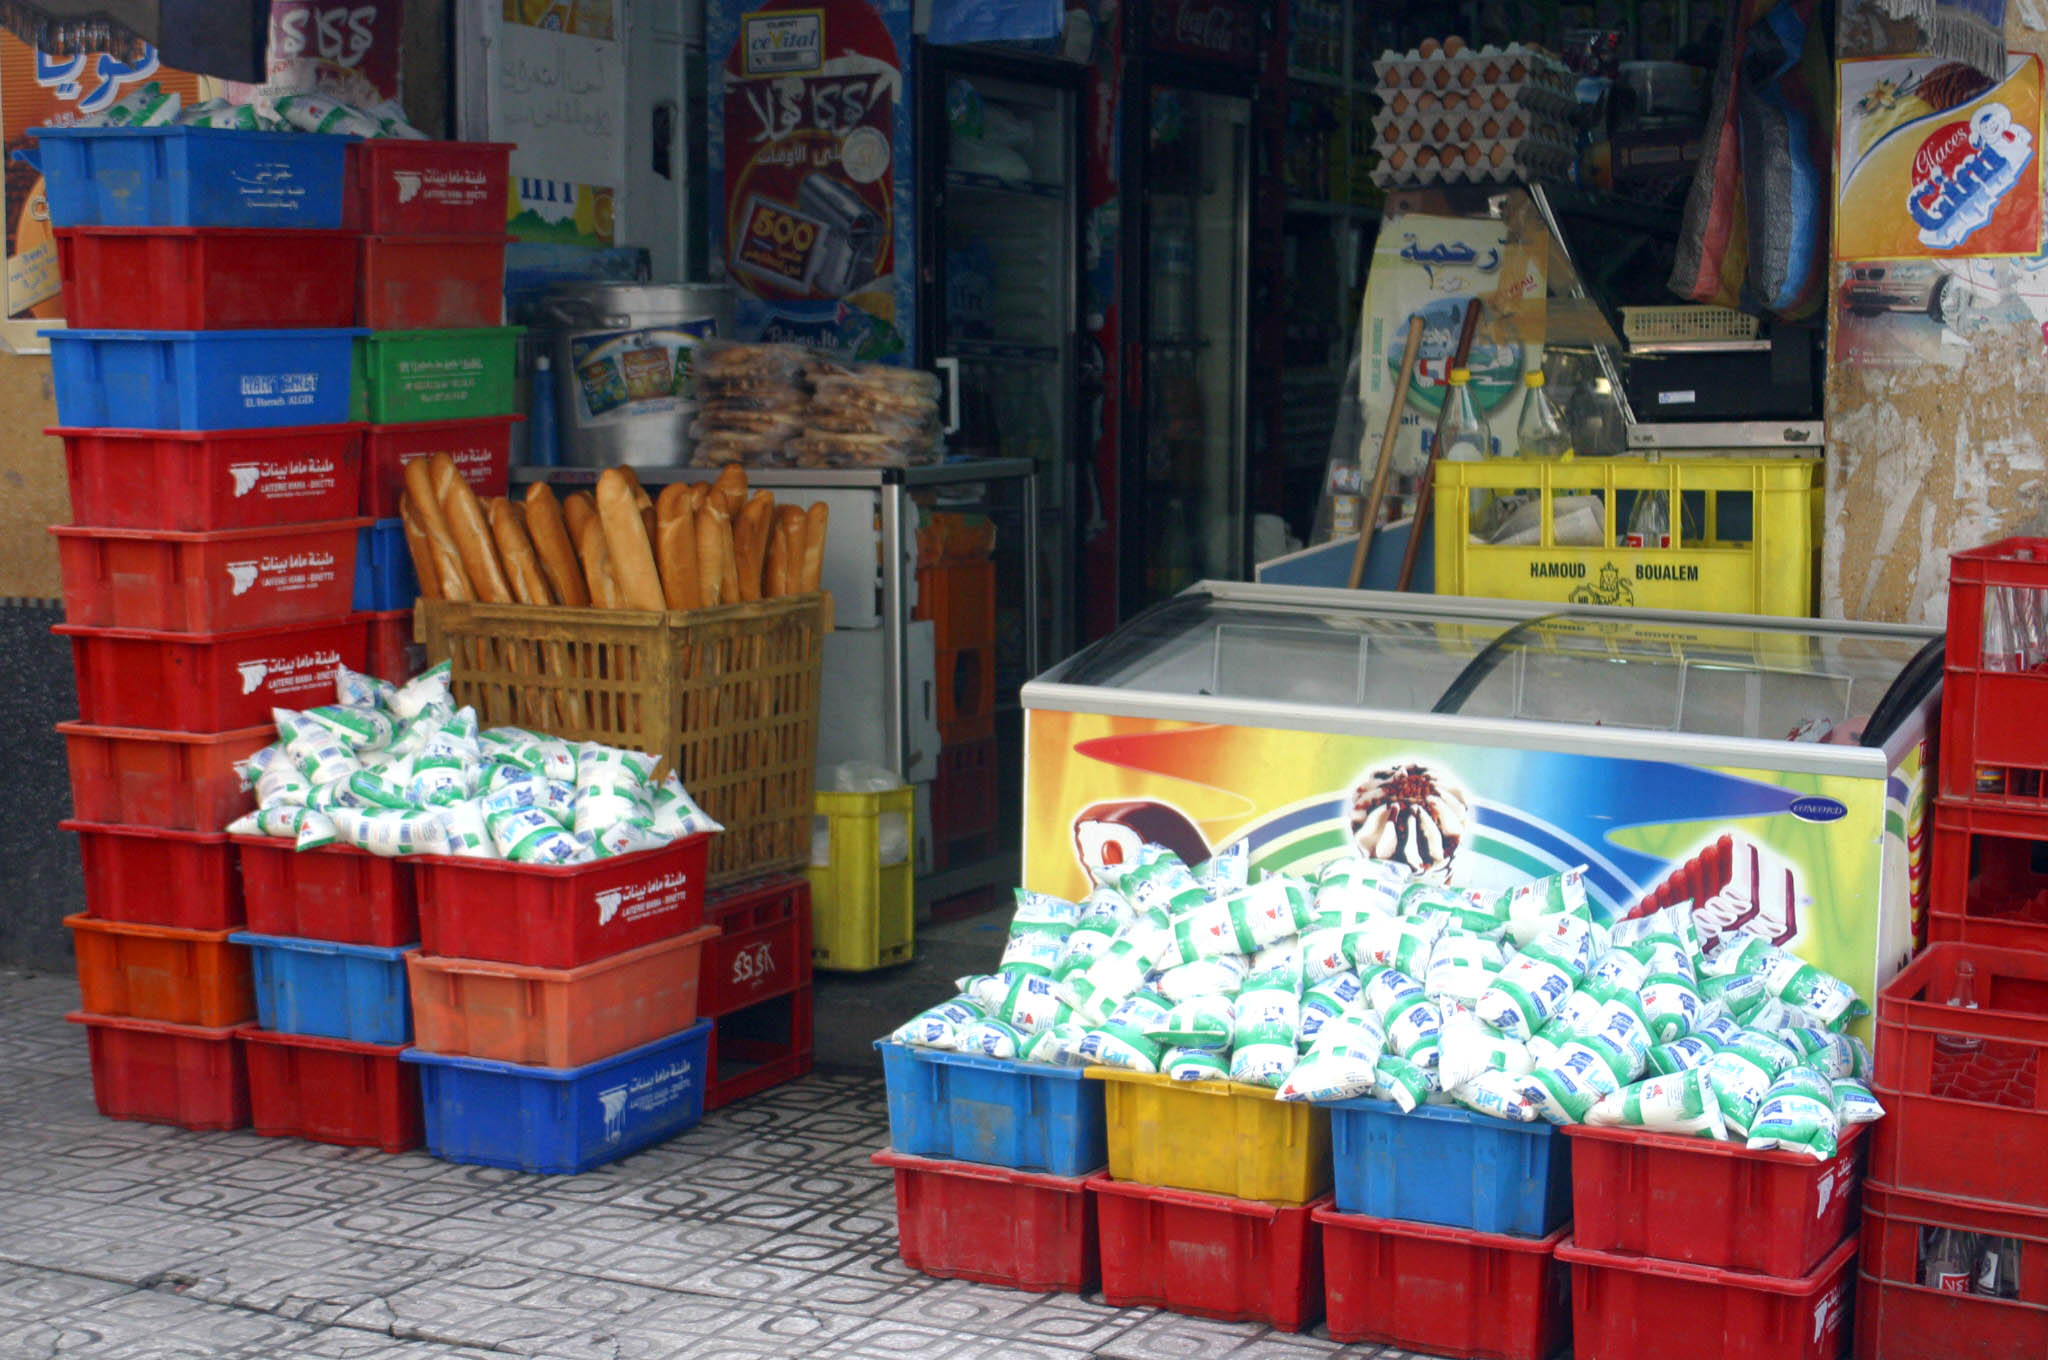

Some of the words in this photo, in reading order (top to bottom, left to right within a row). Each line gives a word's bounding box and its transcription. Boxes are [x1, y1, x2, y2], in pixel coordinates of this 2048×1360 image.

[1916, 128, 1968, 174] Glaces
[751, 207, 814, 253] 500
[261, 462, 288, 480] بينات
[289, 461, 307, 475] ماما
[309, 458, 335, 478] ملبنة
[261, 556, 288, 574] بينات
[289, 553, 307, 568] ماما
[309, 552, 334, 571] ملبنة
[1530, 562, 1586, 578] HAMOUD
[1635, 564, 1699, 582] BOUALEM
[269, 658, 295, 675] بينات
[296, 655, 314, 669] ماما
[315, 649, 340, 670] ملبنة
[647, 878, 663, 894] ماما
[665, 872, 686, 891] ملبنة
[623, 884, 646, 901] بينات
